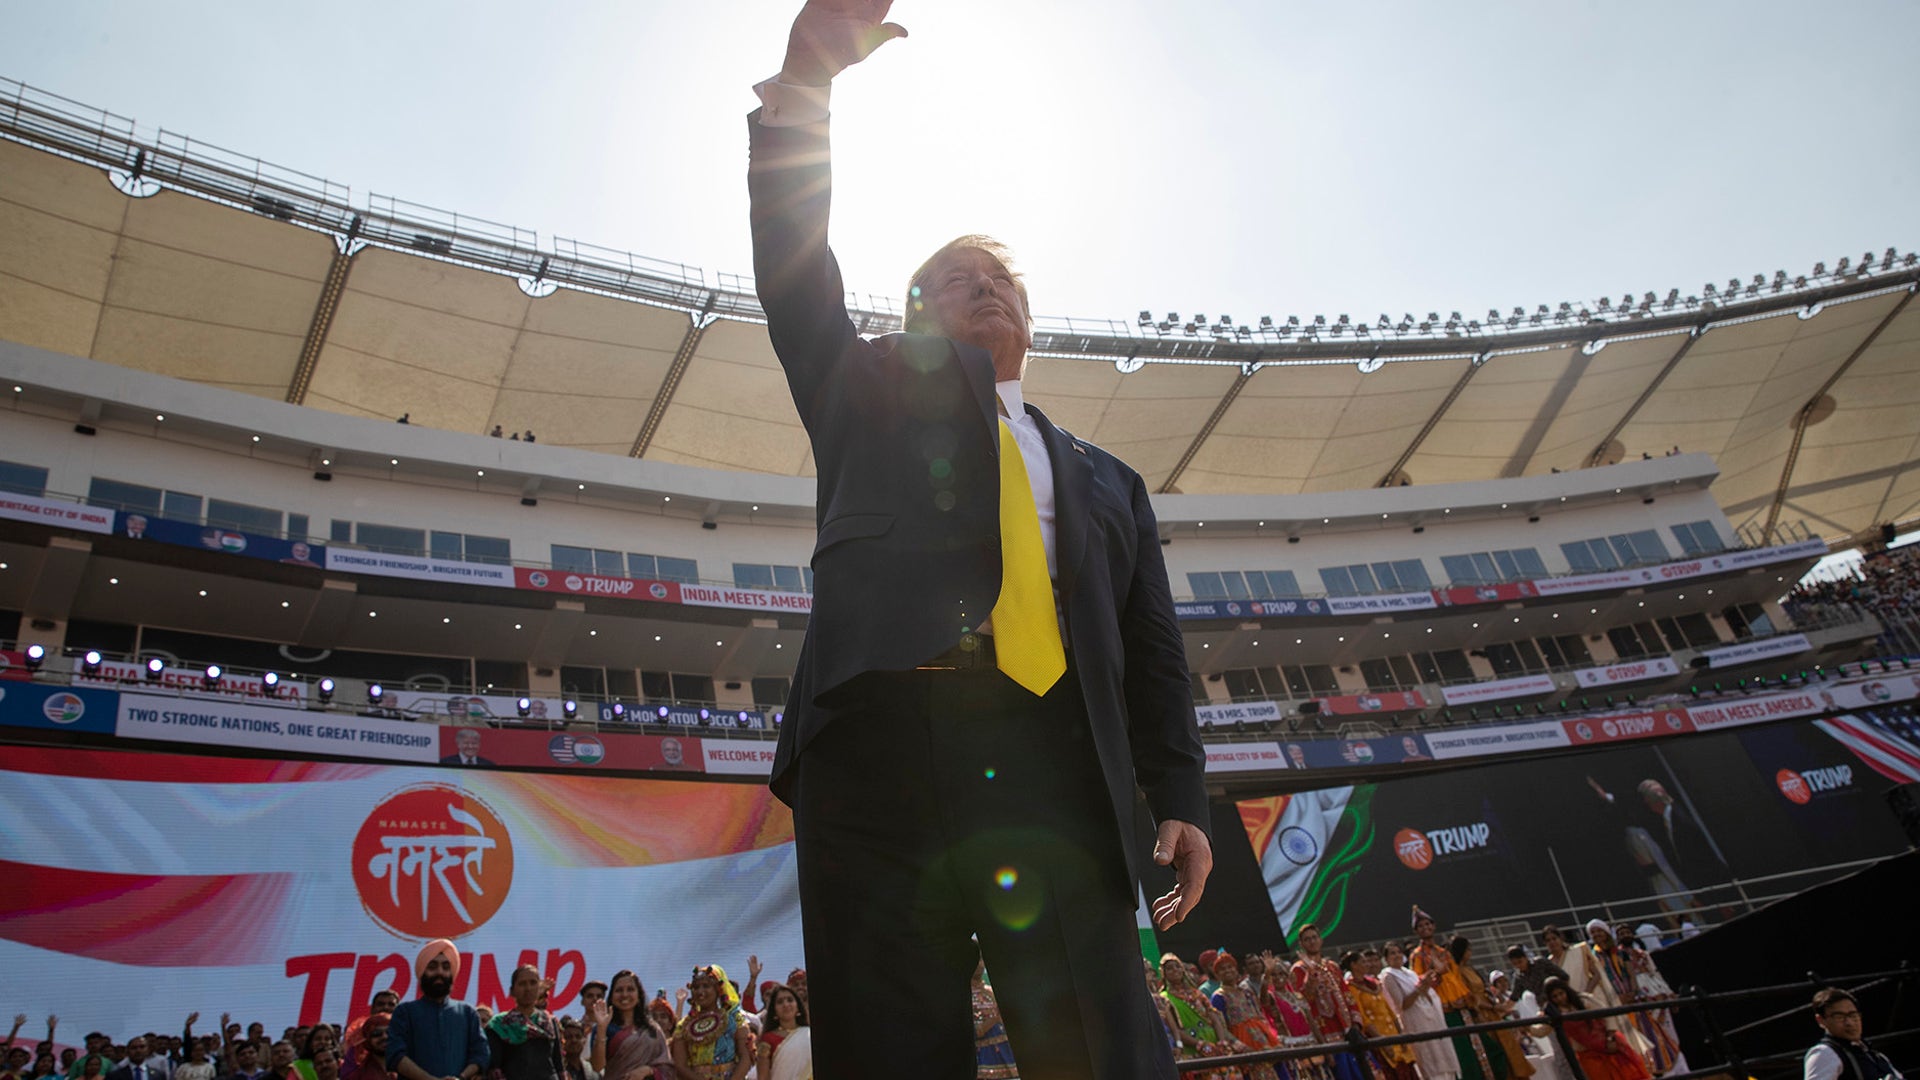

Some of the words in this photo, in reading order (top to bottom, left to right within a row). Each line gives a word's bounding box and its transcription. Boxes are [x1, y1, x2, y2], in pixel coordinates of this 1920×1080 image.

[0, 500, 40, 514] ERITAGE
[43, 507, 65, 518] CITY
[66, 511, 78, 520] OF
[333, 554, 377, 567] STRONGER
[379, 559, 432, 573] FRIENDSHIP,
[432, 566, 472, 577] BRIGHTER
[474, 569, 503, 579] FUTURE
[584, 577, 634, 595] TRUMP
[683, 588, 722, 603] INDIA
[723, 591, 767, 607] MEETS
[771, 594, 813, 609] AMERI
[1262, 601, 1297, 615] TRUMP
[603, 708, 628, 722] OE
[1246, 706, 1275, 717] TRUMP
[1692, 708, 1729, 726] INDIA
[1725, 703, 1767, 720] MEETS
[1765, 696, 1816, 715] AMERICA
[128, 708, 158, 722] TWO
[162, 711, 218, 728] STRONG
[221, 716, 284, 736] NATIONS,
[288, 722, 313, 737] ONE
[317, 725, 357, 742] GREAT
[360, 730, 432, 748] FRIENDSHIP
[1616, 716, 1654, 736] TRUMP
[709, 749, 757, 762] WELCOME
[760, 751, 776, 763] PR
[1800, 764, 1853, 792] TRUMP
[379, 820, 447, 830] NAMASTE
[1426, 822, 1490, 855] TRUMP
[368, 803, 496, 924] नमस्ते
